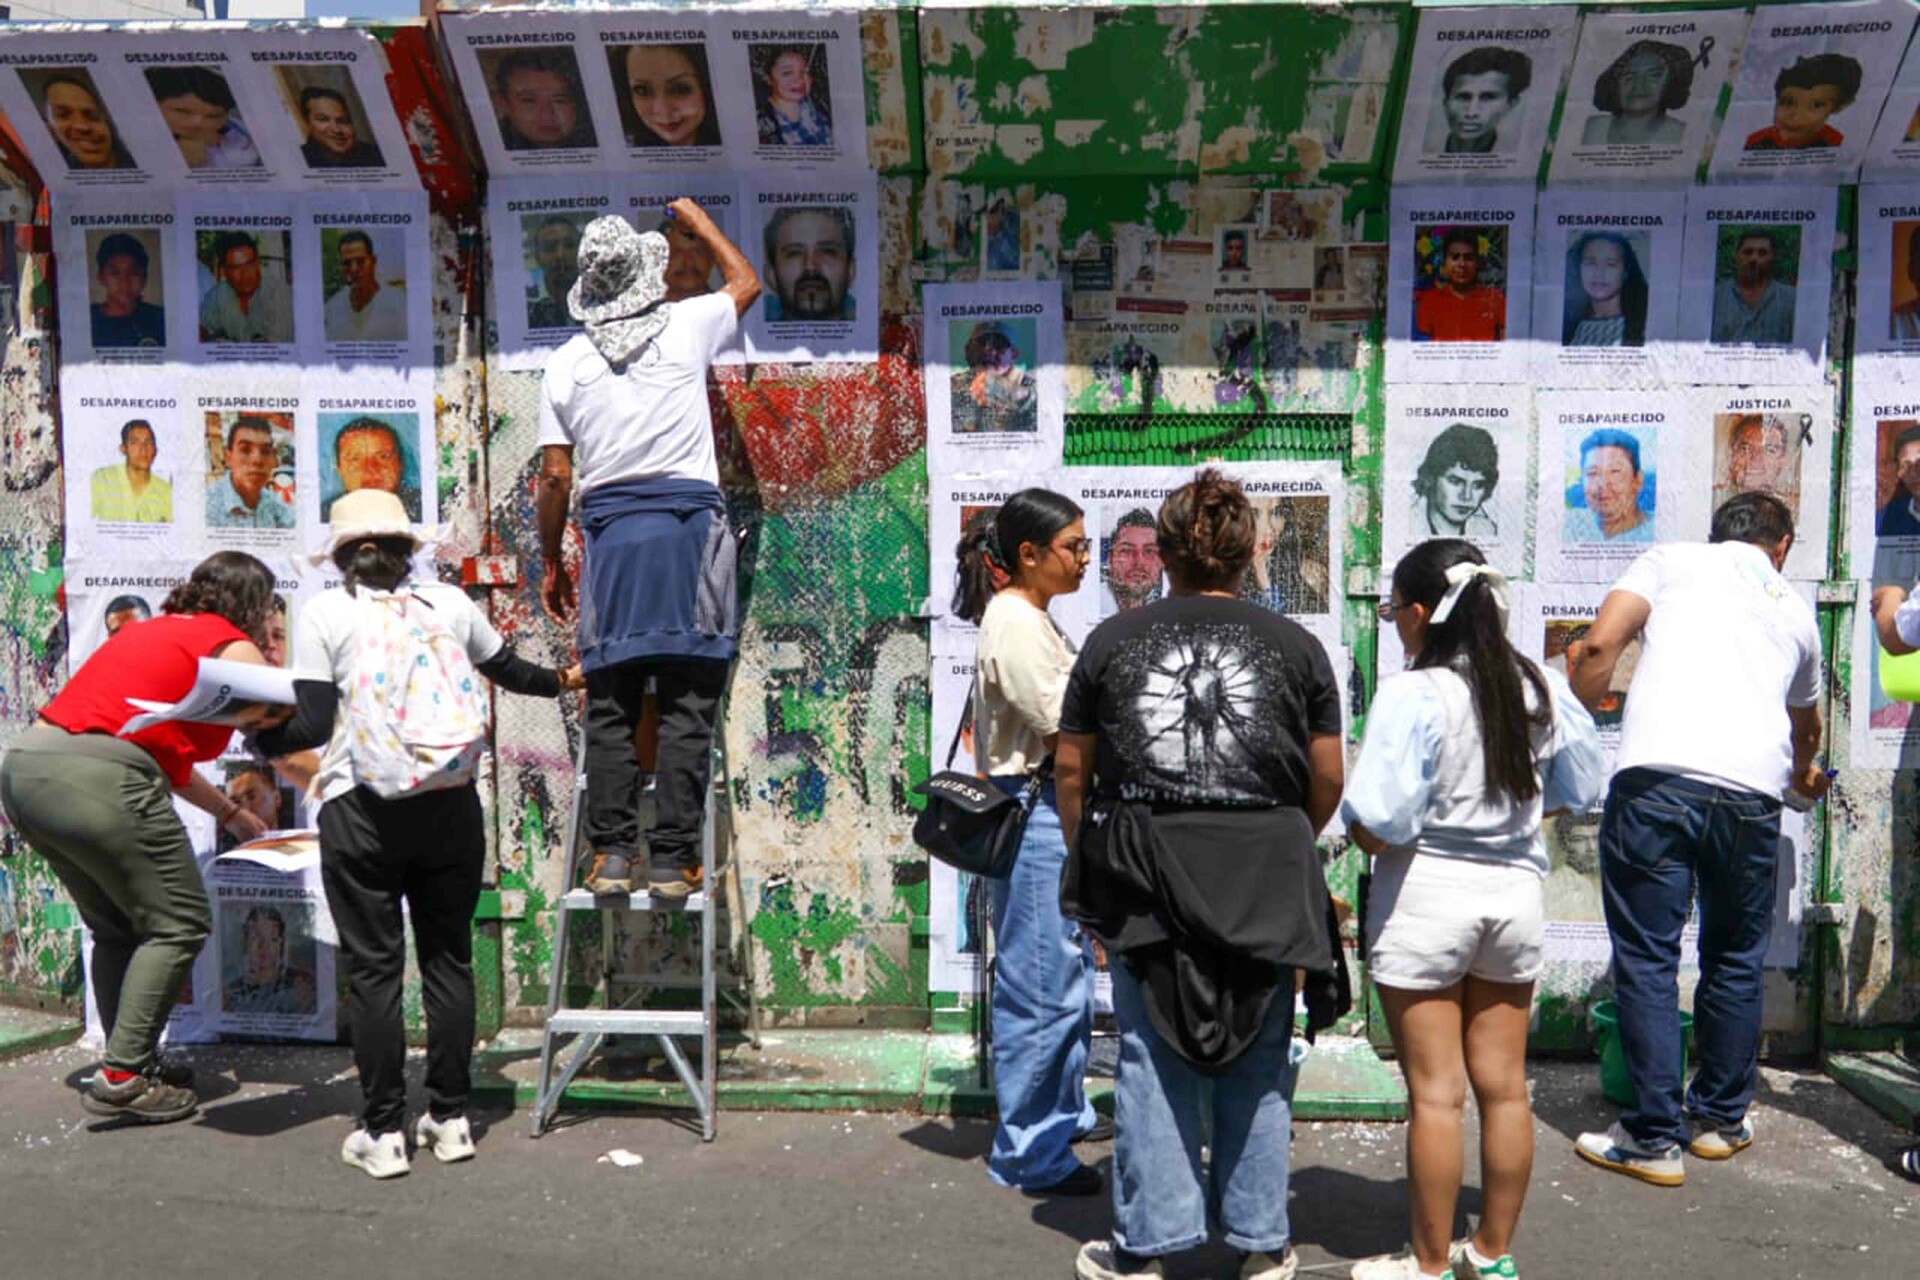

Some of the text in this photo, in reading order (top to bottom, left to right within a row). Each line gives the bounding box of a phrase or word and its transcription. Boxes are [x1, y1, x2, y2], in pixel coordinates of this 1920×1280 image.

[731, 29, 840, 40] DESAPARECIDA
[1437, 29, 1551, 41] DESAPARECIDO
[1626, 23, 1696, 36] JUSTICIA
[1771, 21, 1892, 39] DESAPARECIDO
[467, 31, 576, 46] DESAPARECIDO
[600, 30, 707, 42] DESAPARECIDA
[0, 53, 98, 64] ESAPARECIDO
[124, 52, 229, 63] DESAPARECIDA
[251, 51, 357, 62] DESAPARECIDO
[629, 195, 731, 207] DESACIDO
[758, 192, 860, 203] DESAPARECIDO
[508, 196, 609, 212] DESAPARECIDO
[70, 214, 174, 226] DESAPARECIDO
[194, 215, 292, 226] DESAPARECIDO
[313, 213, 412, 225] DESAPARECIDO
[1409, 210, 1515, 221] DESAPARECIDO
[1557, 215, 1664, 226] DESAPARECIDA
[1706, 209, 1816, 221] DESAPARECIDO
[941, 303, 1043, 316] DESAPARECIDO
[80, 397, 177, 408] DESAPARECIDO
[198, 396, 299, 408] DESAPARECIDO
[319, 398, 416, 409] DESAPARECIDO
[1726, 398, 1792, 409] JUSTICIA
[1405, 407, 1509, 418] DESAPARECIDO
[1559, 412, 1665, 424] DESAPARECIDO
[1244, 480, 1324, 493] APARECIDA
[217, 886, 318, 899] DESAPARECIDA
